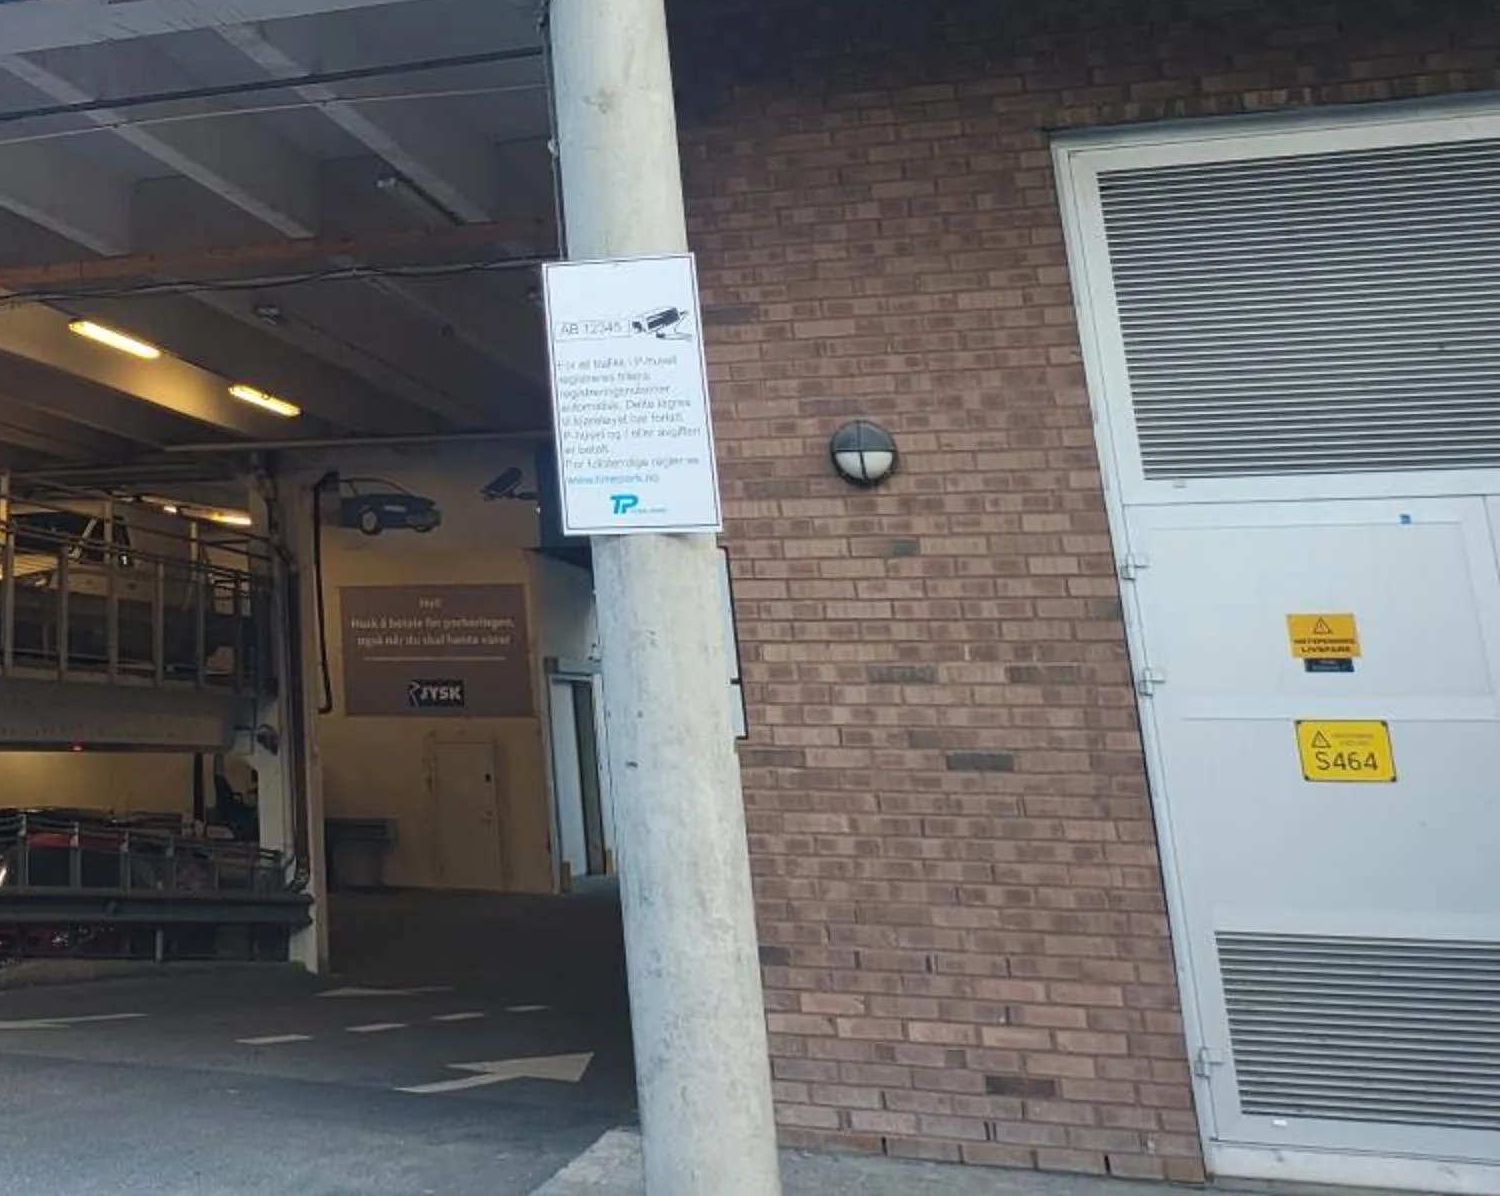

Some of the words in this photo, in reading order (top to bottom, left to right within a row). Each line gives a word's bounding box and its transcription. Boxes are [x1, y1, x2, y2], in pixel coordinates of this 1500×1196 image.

[610, 493, 639, 515] TP
[419, 686, 462, 701] JYSK
[1315, 751, 1379, 772] S464
